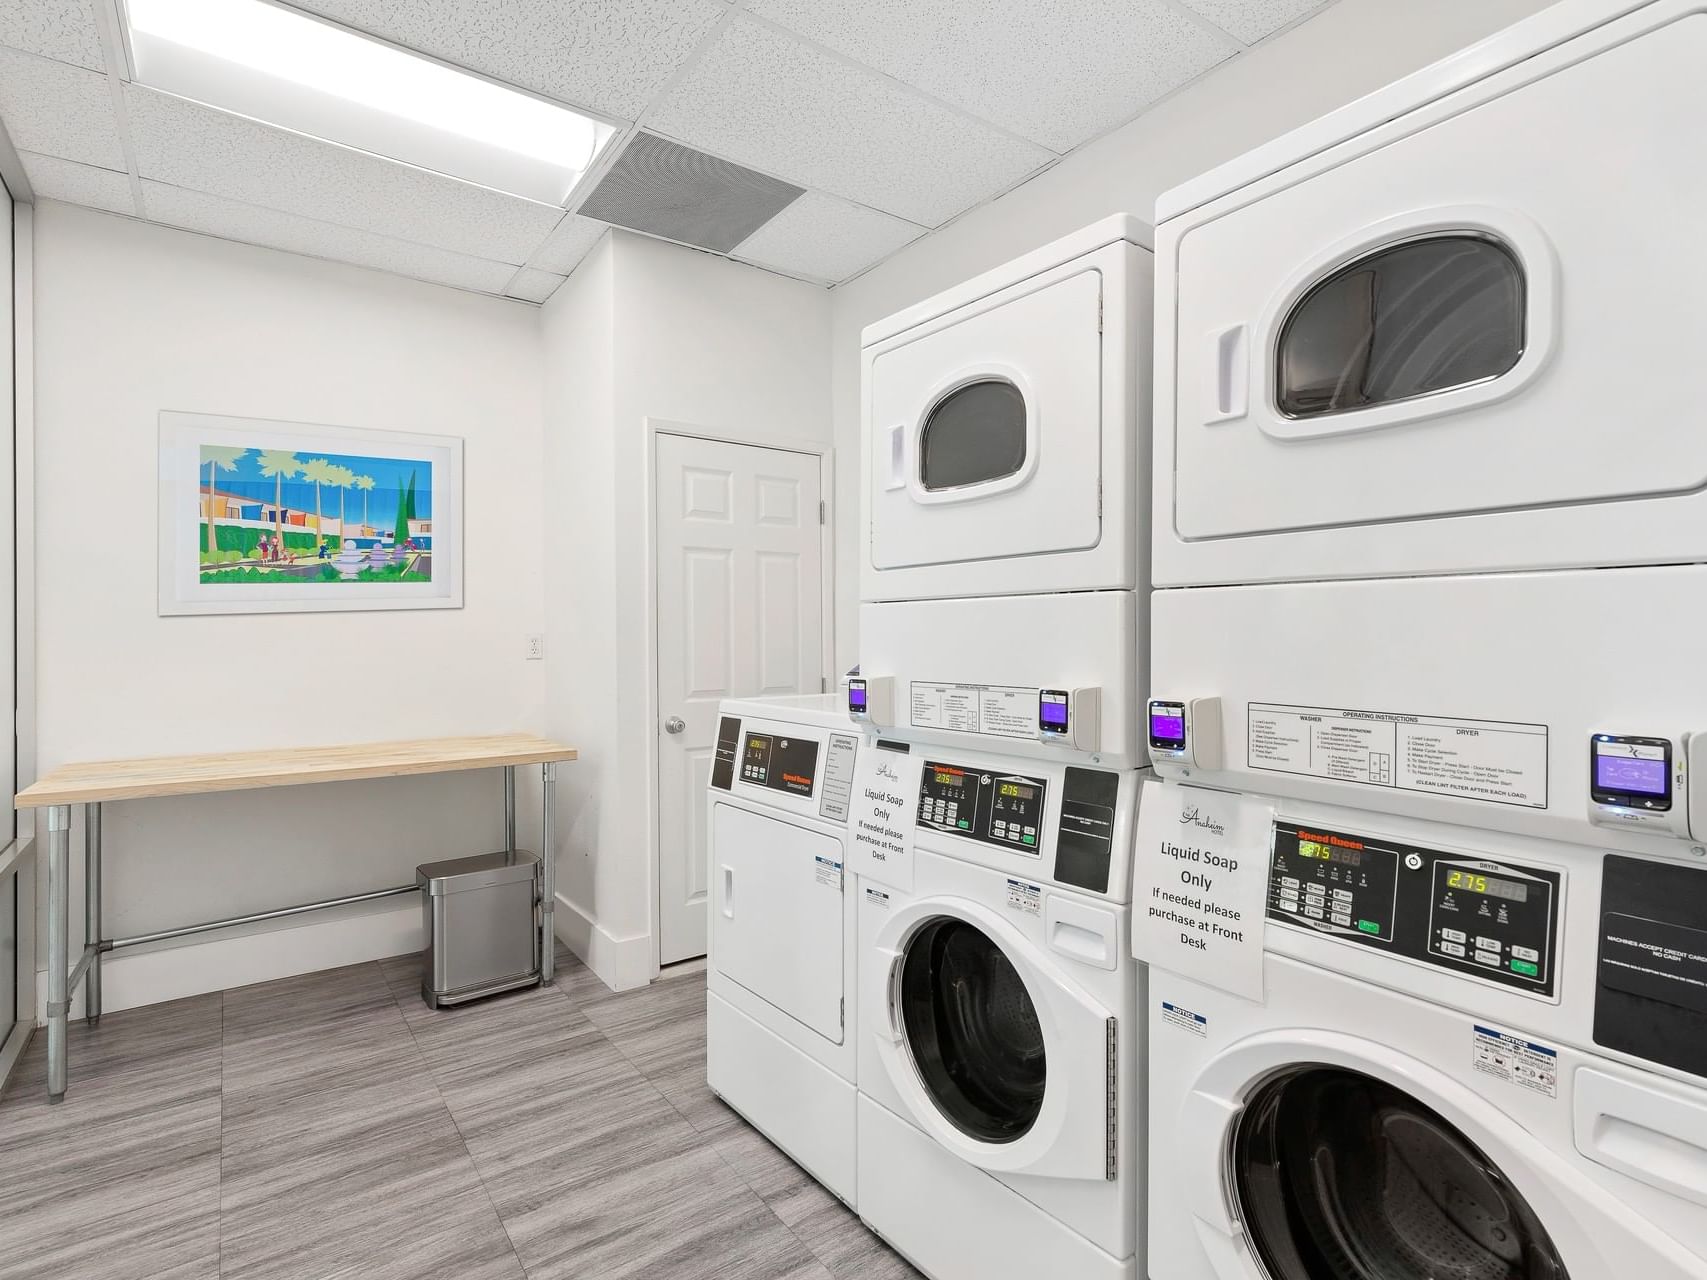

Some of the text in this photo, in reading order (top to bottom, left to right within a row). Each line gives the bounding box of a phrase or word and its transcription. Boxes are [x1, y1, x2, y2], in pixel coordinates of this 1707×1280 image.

[1299, 715, 1322, 723] WASHER
[1342, 711, 1418, 723] OPERATING INSTRUCTIONS
[1456, 729, 1479, 737] DRYER
[865, 788, 904, 807] Liquid Soap
[1508, 791, 1528, 800] LOAD)
[873, 807, 890, 822] Only
[1179, 807, 1225, 831] Anaheim
[859, 820, 904, 841] If needed please
[856, 833, 904, 855] purchase at Front
[1298, 831, 1363, 851] Speed Queen
[872, 850, 886, 862] Desk
[1161, 841, 1239, 872] Liquid Soap
[1479, 863, 1499, 872] DRYER
[1180, 870, 1212, 892] Only
[1449, 872, 1487, 894] 2.75
[1152, 887, 1242, 921] If needed please
[1149, 906, 1244, 943] purchase at Front
[1313, 921, 1333, 931] WASHER
[1180, 933, 1208, 951] Desk
[1607, 935, 1638, 947] MACHINES
[1638, 942, 1664, 952] ACCEPT
[1664, 948, 1687, 958] CREDIT
[1663, 953, 1682, 962] CASH
[1172, 1005, 1196, 1020] NOTICE
[1499, 1032, 1530, 1048] NOTICE
